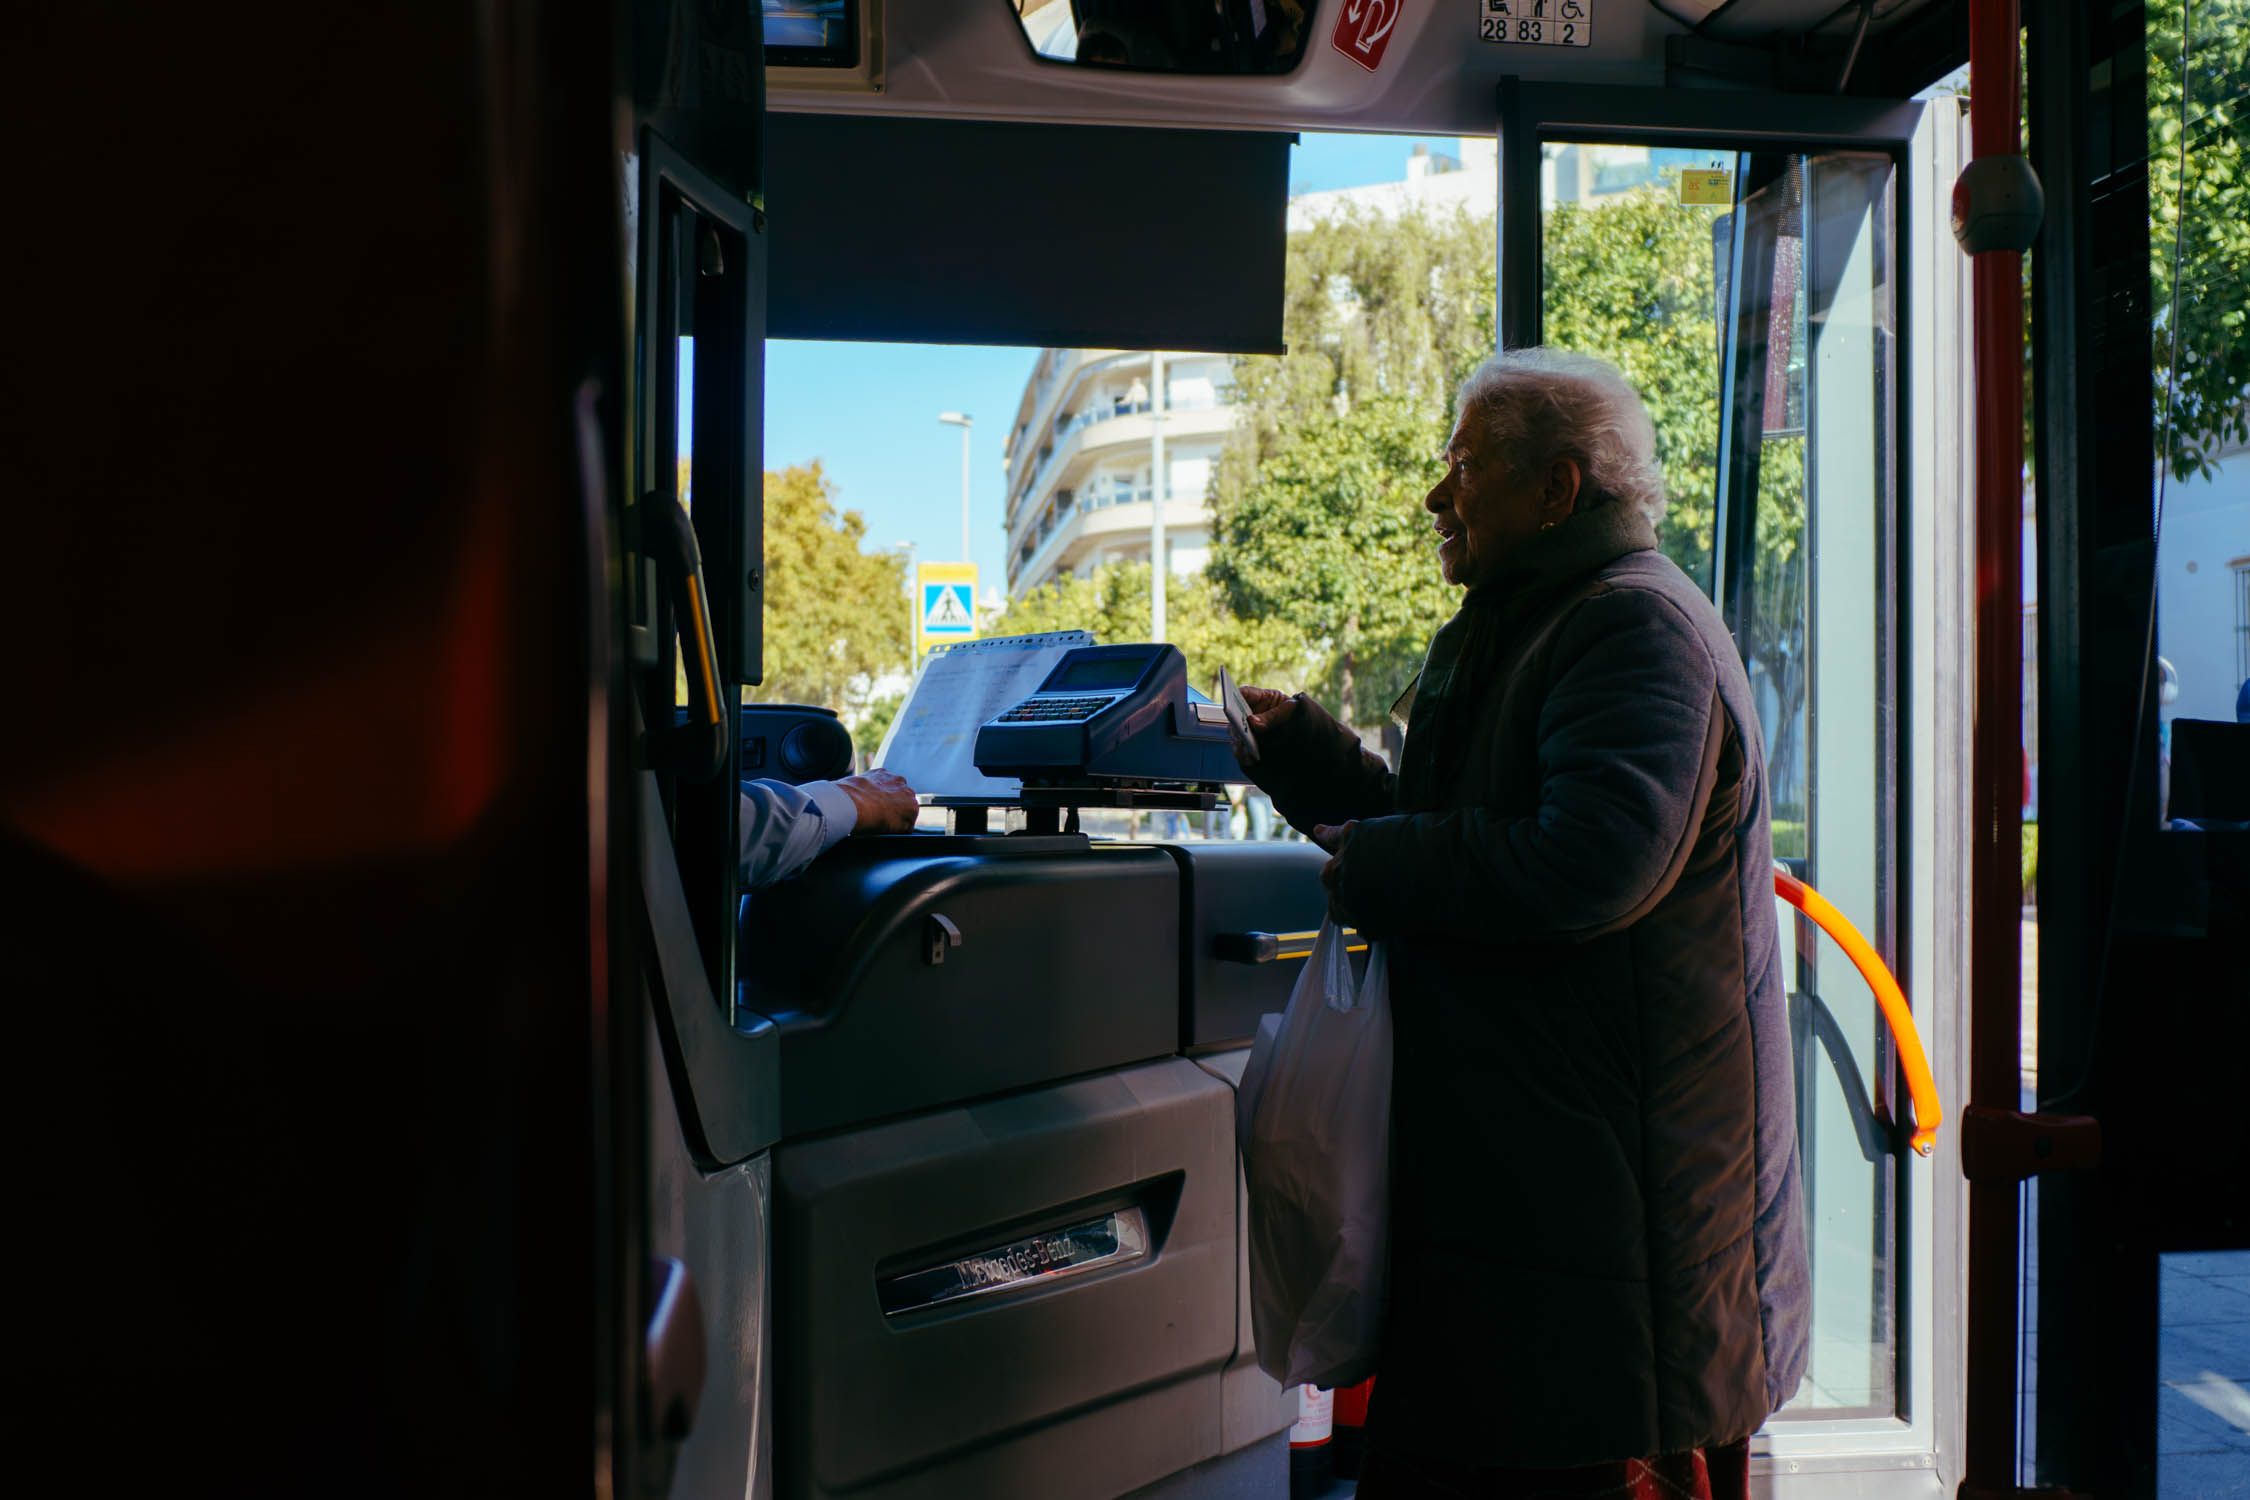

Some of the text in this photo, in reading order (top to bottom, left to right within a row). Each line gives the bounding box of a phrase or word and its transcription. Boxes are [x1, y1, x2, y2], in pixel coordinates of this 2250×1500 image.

[1483, 19, 1574, 44] 28 83 2
[956, 1236, 1076, 1290] Mercedes-Benz
